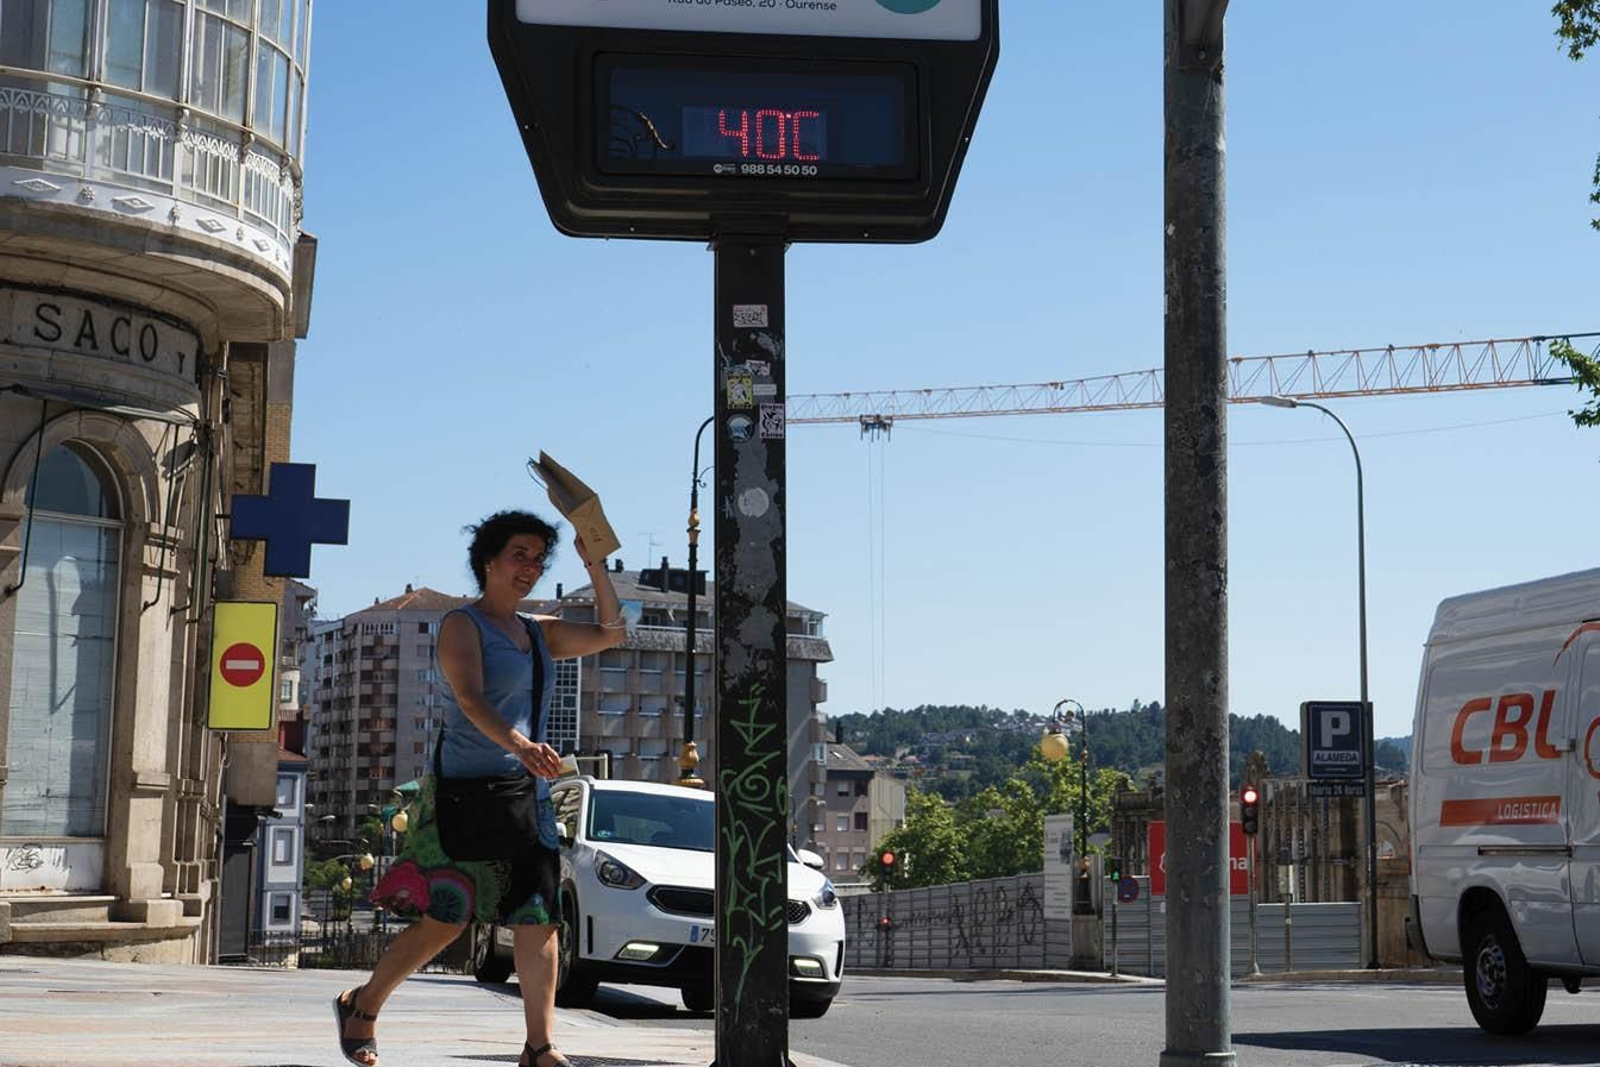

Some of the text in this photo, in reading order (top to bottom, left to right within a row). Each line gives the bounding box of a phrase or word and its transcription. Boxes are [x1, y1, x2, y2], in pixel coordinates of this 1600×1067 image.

[758, 0, 776, 8] 20
[785, 0, 837, 11] Ourense
[741, 163, 765, 174] 988
[766, 164, 782, 175] 54
[784, 165, 800, 175] 50
[801, 165, 818, 176] 50
[34, 302, 159, 362] SACO
[1321, 711, 1350, 748] P
[1451, 690, 1562, 766] CBL
[1315, 751, 1359, 762] ALAMEDA
[1498, 802, 1557, 819] LOGISTICA
